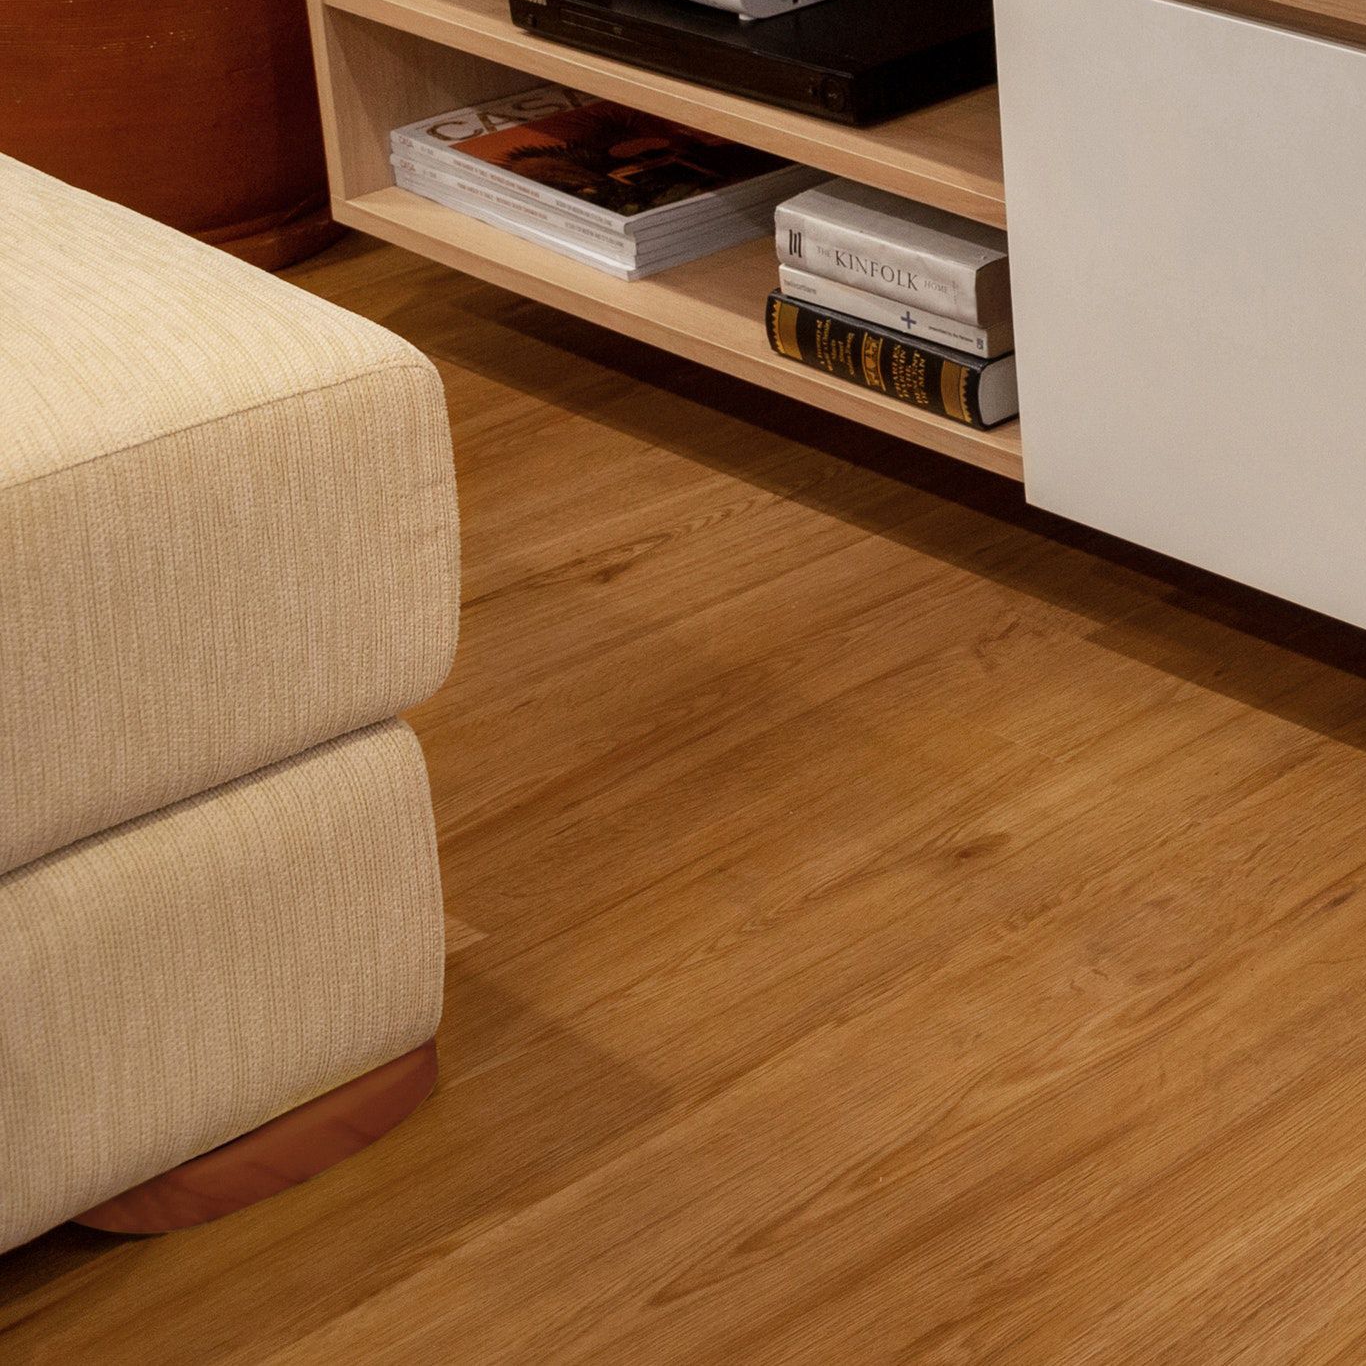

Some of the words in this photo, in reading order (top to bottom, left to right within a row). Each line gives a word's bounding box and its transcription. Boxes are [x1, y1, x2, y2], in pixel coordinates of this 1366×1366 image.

[426, 88, 592, 142] CAS
[817, 246, 831, 258] THE
[835, 250, 918, 291] KINFOLK
[924, 280, 948, 293] HOME
